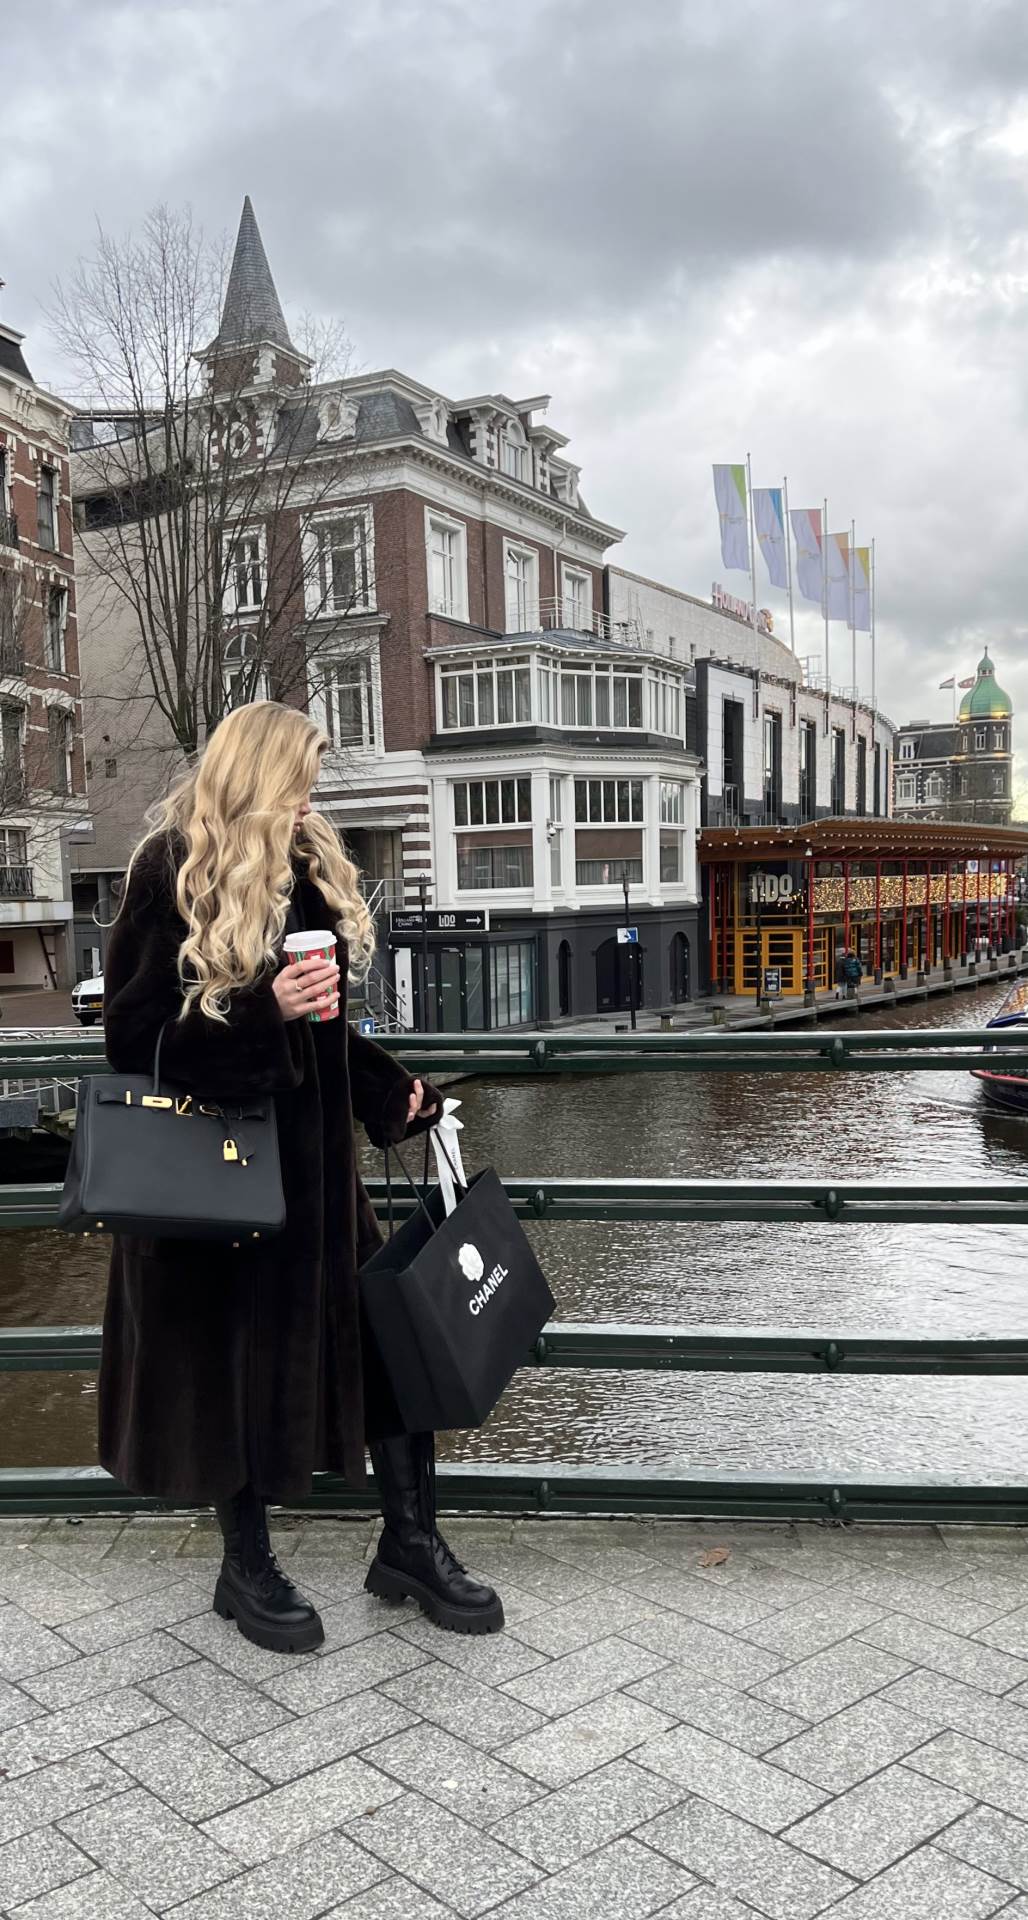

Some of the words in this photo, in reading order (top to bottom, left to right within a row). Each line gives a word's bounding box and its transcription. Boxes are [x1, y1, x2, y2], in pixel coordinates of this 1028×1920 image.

[752, 873, 793, 903] LIDO
[438, 914, 456, 927] LIDO
[469, 1263, 509, 1316] CHANEL
